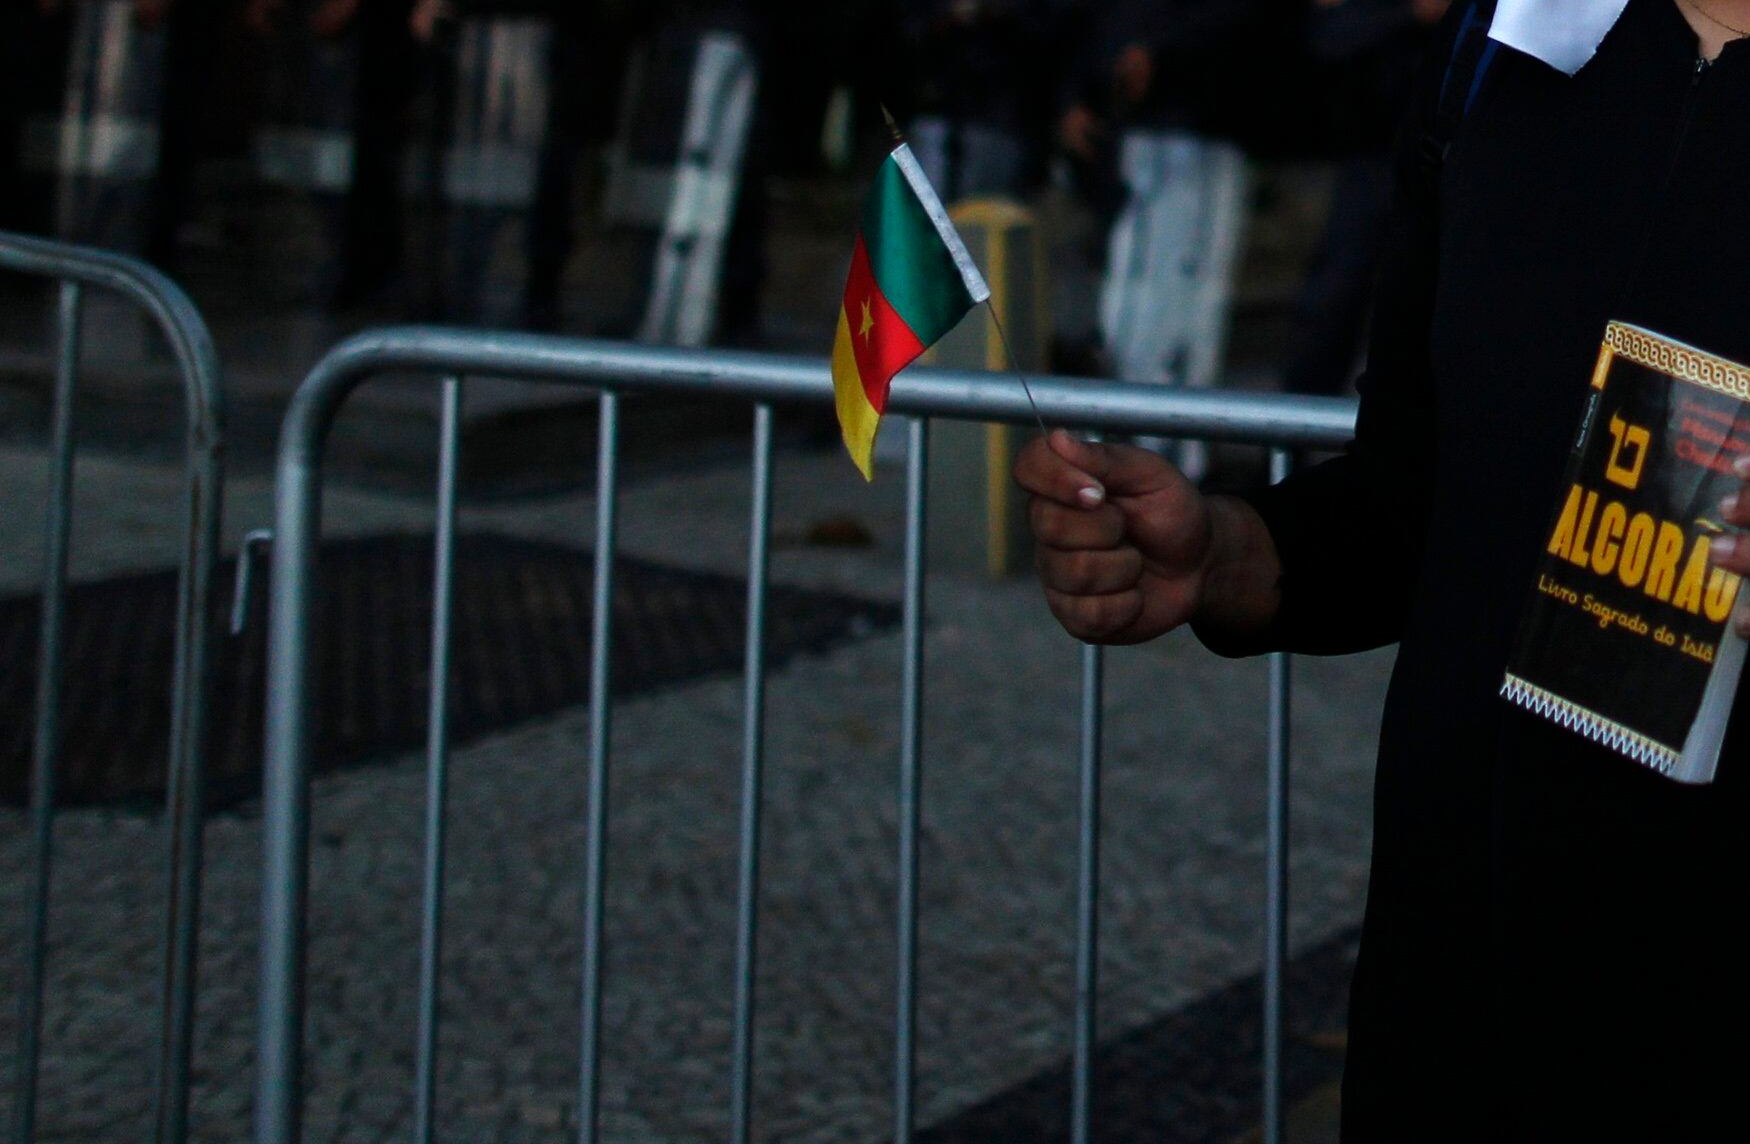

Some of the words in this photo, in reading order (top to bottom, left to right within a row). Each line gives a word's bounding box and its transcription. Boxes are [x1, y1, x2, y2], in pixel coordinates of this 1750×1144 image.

[1538, 574, 1578, 604] Livro
[1582, 594, 1649, 636] Sagrado
[1654, 625, 1676, 646] do
